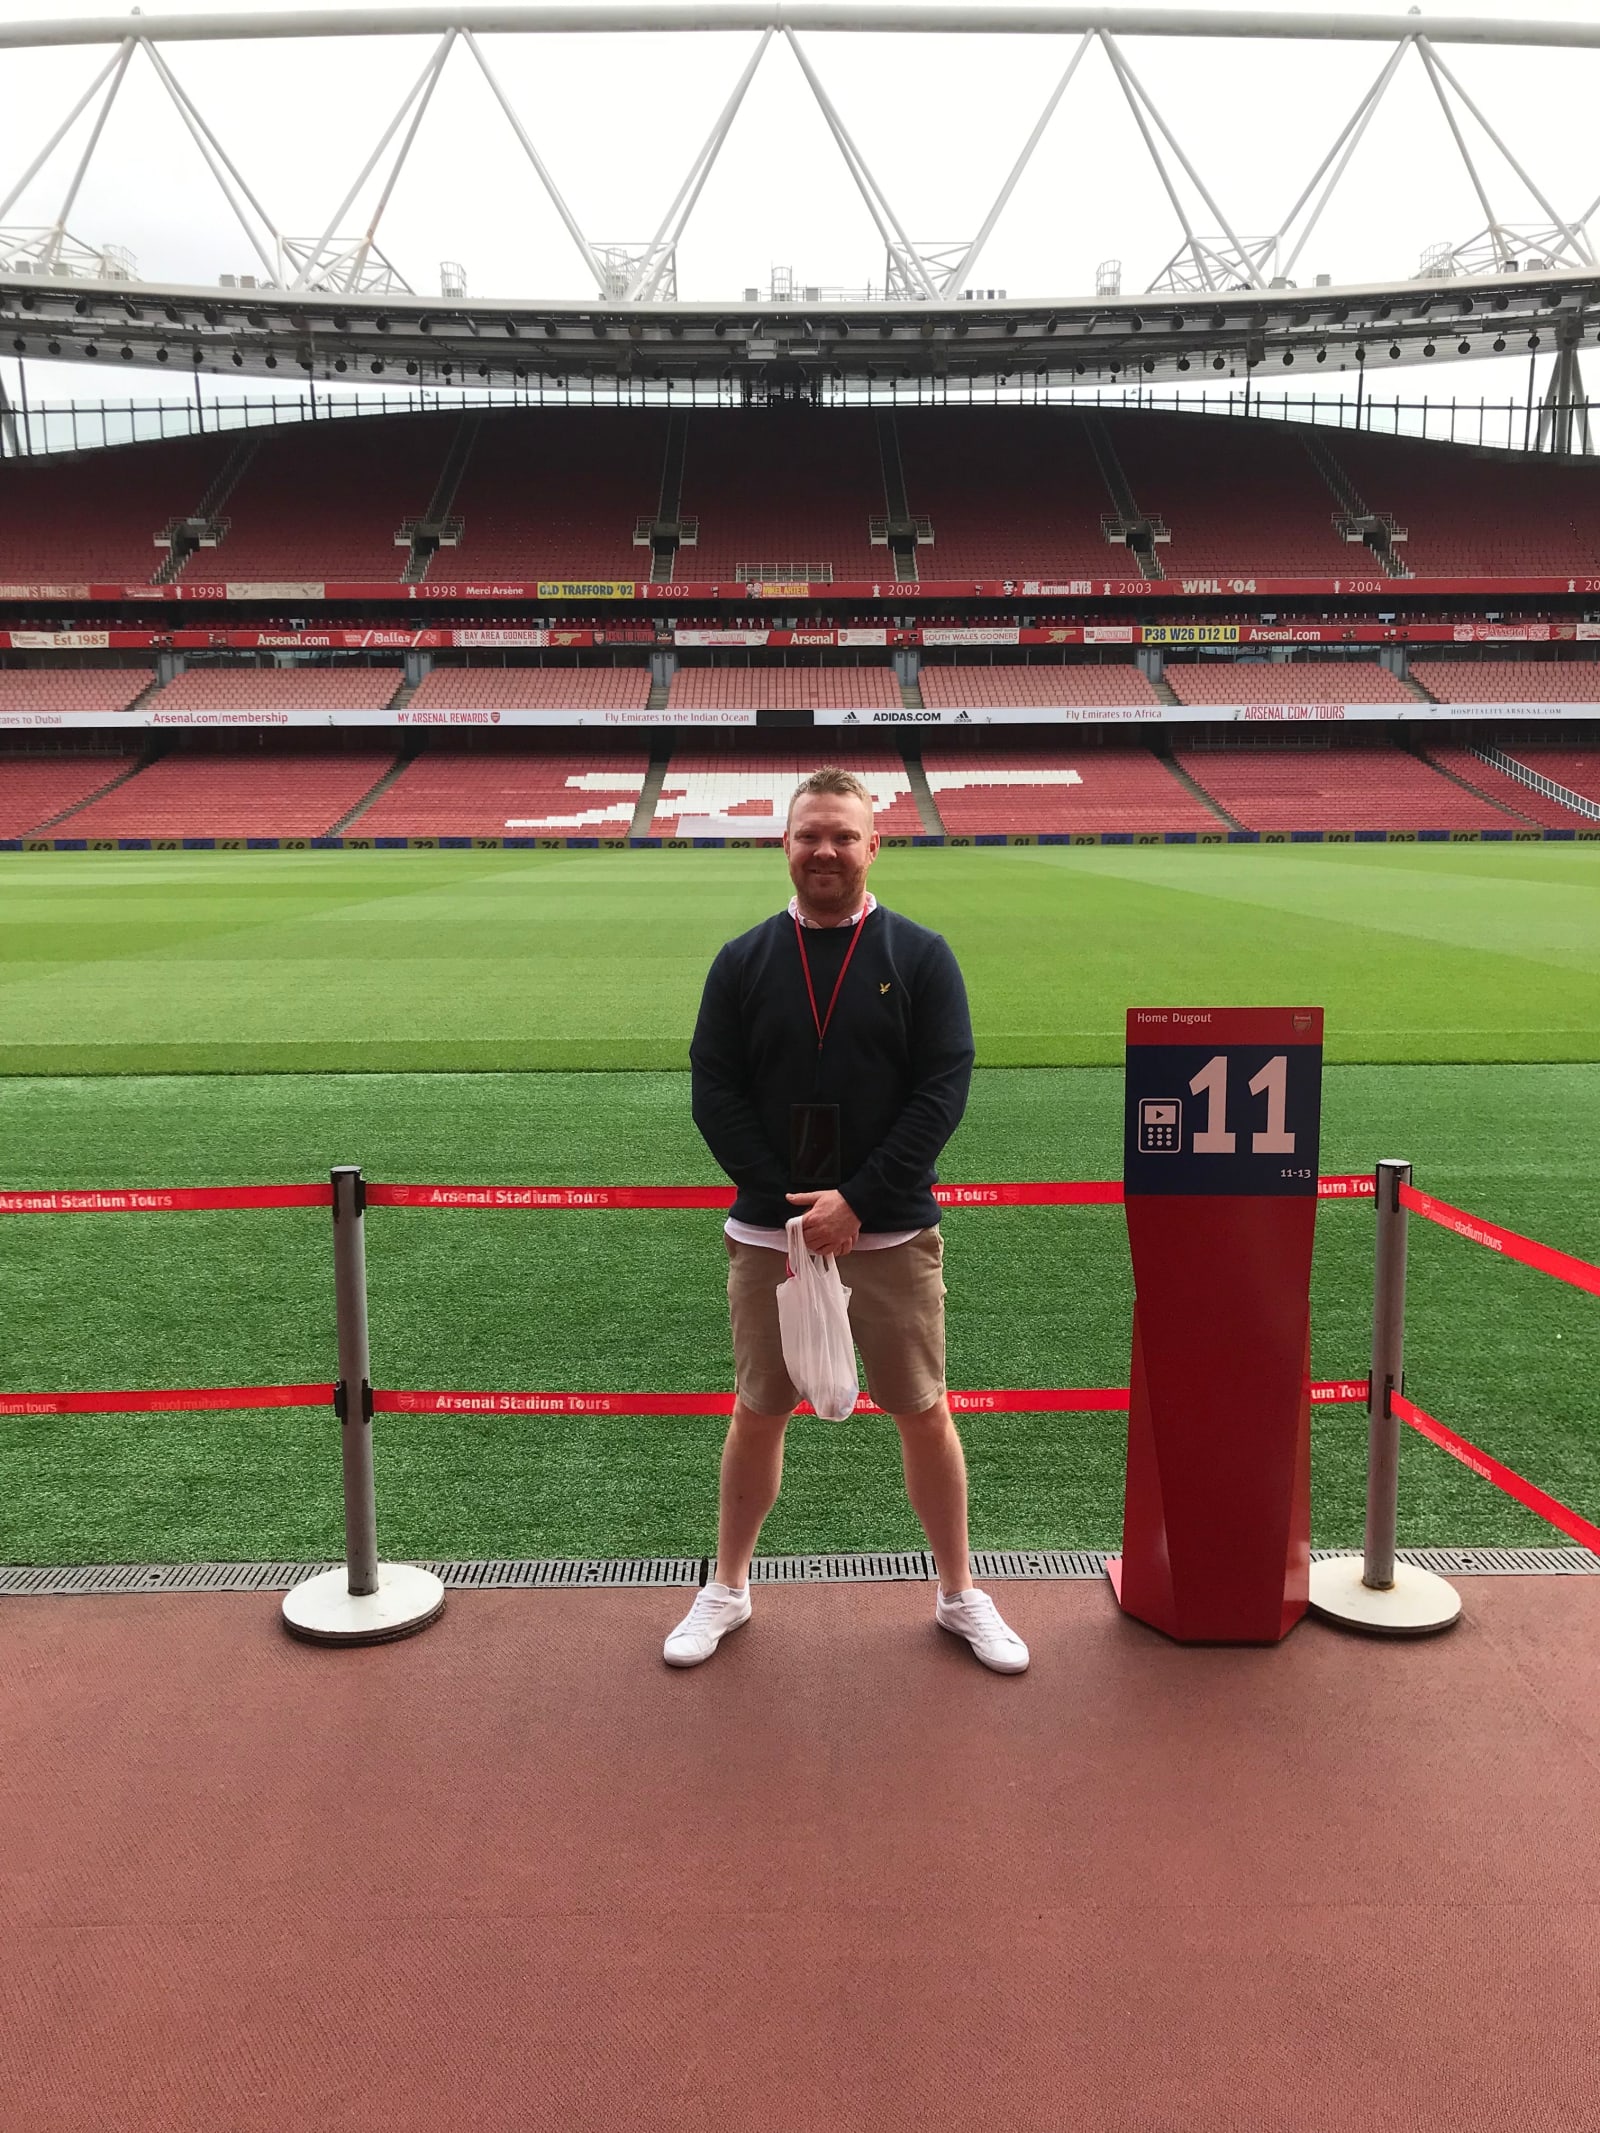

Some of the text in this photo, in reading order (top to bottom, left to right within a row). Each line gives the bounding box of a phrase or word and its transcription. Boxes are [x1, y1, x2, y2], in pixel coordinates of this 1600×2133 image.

[424, 586, 457, 597] 1998
[466, 586, 524, 595] Merci Arsène
[562, 584, 614, 596] TRAFFORD
[656, 586, 690, 597] 2002
[887, 584, 921, 596] 2002
[1119, 583, 1152, 594] 2003
[1182, 580, 1222, 593] WHL
[1348, 581, 1382, 592] 2004
[1585, 580, 1600, 591] 20
[191, 587, 224, 597] 1998
[78, 633, 107, 645] 1985
[257, 633, 330, 646] Arsenal.com
[464, 631, 538, 640] BAY AREA GOONERS
[790, 632, 834, 645] Arsenal
[980, 632, 1018, 640] GOONERS
[1144, 628, 1166, 640] P38
[1170, 628, 1195, 640] W26
[1198, 628, 1220, 640] D12
[1249, 628, 1321, 641] Arsenal.com
[0, 715, 62, 725] rates to Dubai
[153, 712, 288, 724] Arsenal.com/membership
[398, 712, 489, 723] MY ARSENAL REWARDS
[605, 712, 750, 724] Fly Emirates to the Indian Ocean
[873, 712, 941, 722] ADIDAS.COM
[1066, 709, 1162, 720] Fly Emirates to Africa
[1137, 1013, 1212, 1025] Home Dugout
[1188, 1055, 1296, 1154] 11
[1280, 1169, 1311, 1178] 11-13
[1351, 1179, 1376, 1193] Tou
[0, 1193, 173, 1209] Arsenal Stadium Tours
[431, 1189, 608, 1204] Arsenal Stadium Tours
[954, 1188, 998, 1202] Tours
[1454, 1220, 1503, 1251] stadium tours
[1338, 1384, 1366, 1398] Tou
[436, 1395, 610, 1410] Arsenal Stadium Tours
[952, 1394, 995, 1408] Tours
[26, 1402, 57, 1413] tours
